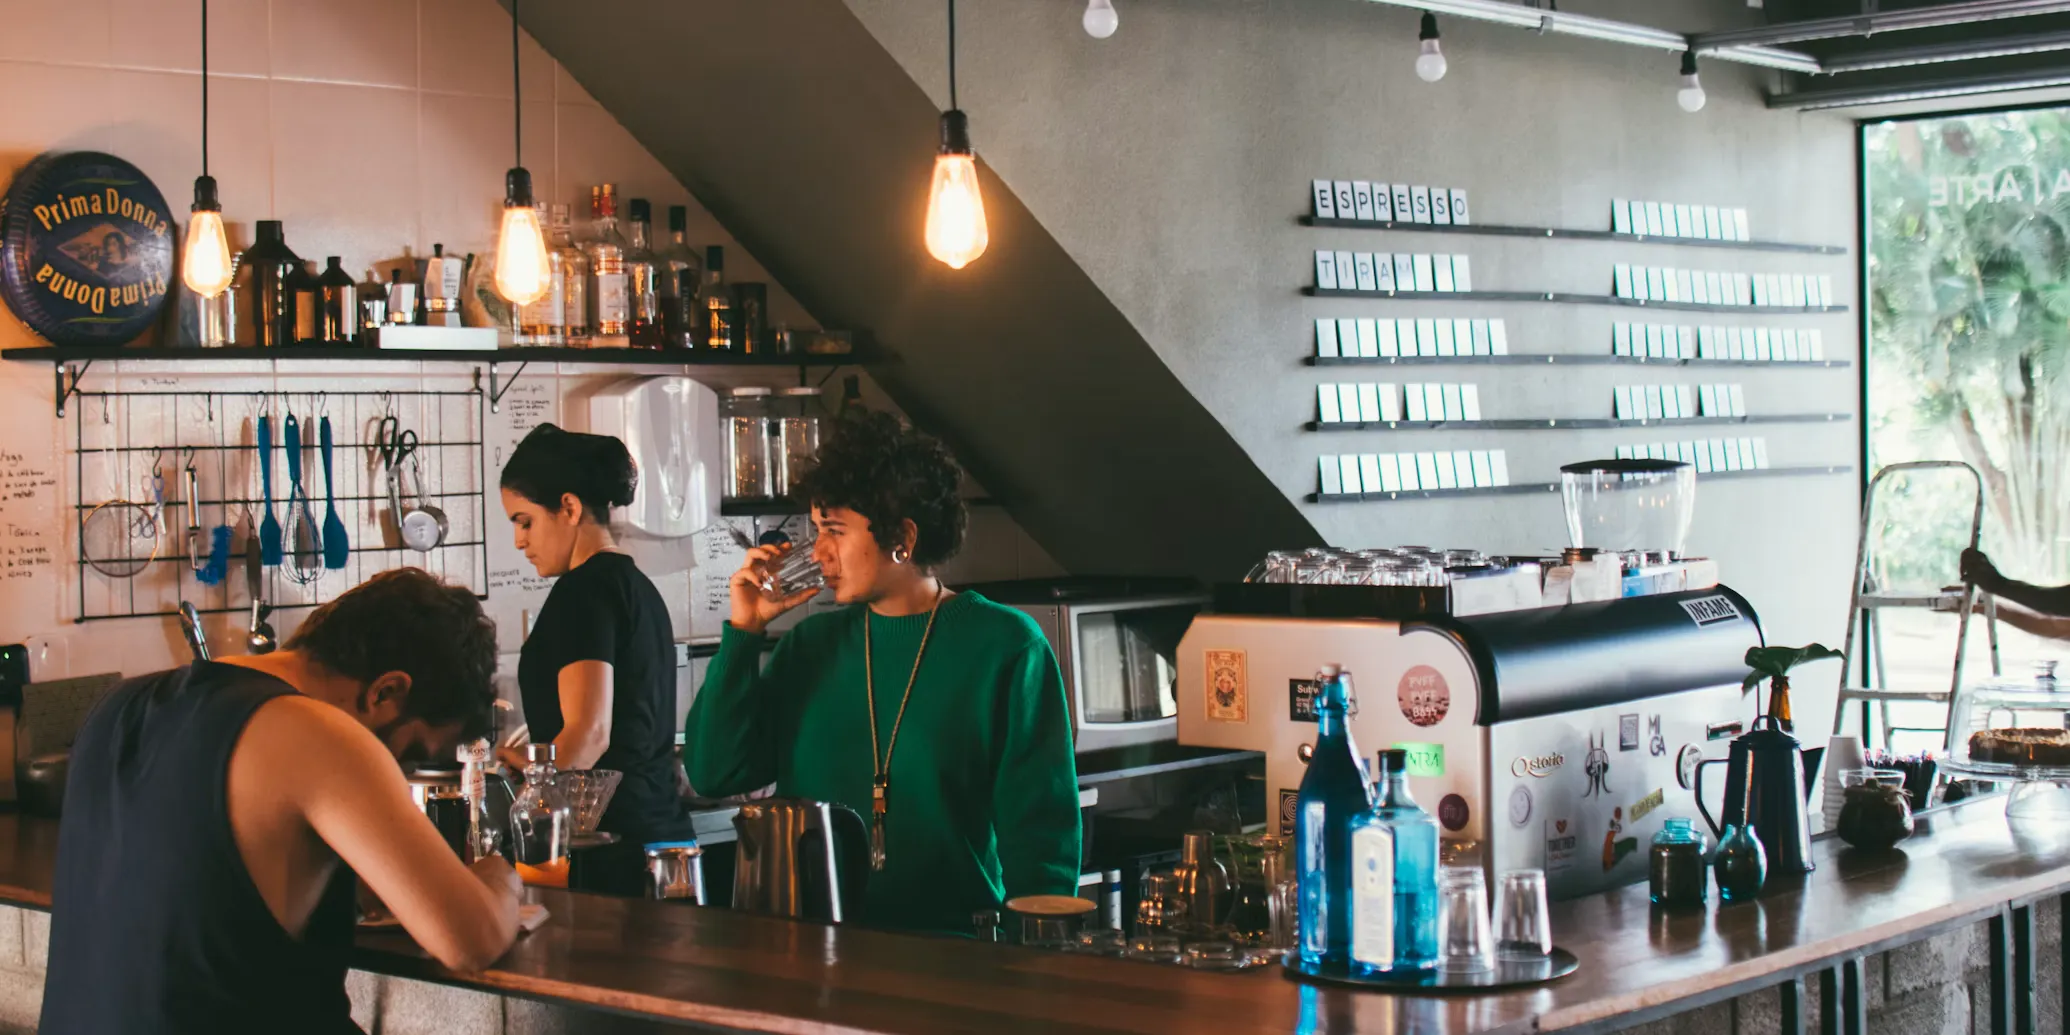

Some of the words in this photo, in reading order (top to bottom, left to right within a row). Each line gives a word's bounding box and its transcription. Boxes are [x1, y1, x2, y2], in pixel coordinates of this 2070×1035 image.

[33, 193, 103, 231] Prima
[105, 187, 168, 238] Donna
[1319, 189, 1466, 215] ESPRESSO
[36, 262, 105, 314] Donna
[109, 271, 167, 307] Prima
[1686, 597, 1735, 621] INFAME
[1648, 713, 1661, 735] MI
[1649, 735, 1667, 757] GA
[1408, 751, 1440, 769] NTRA
